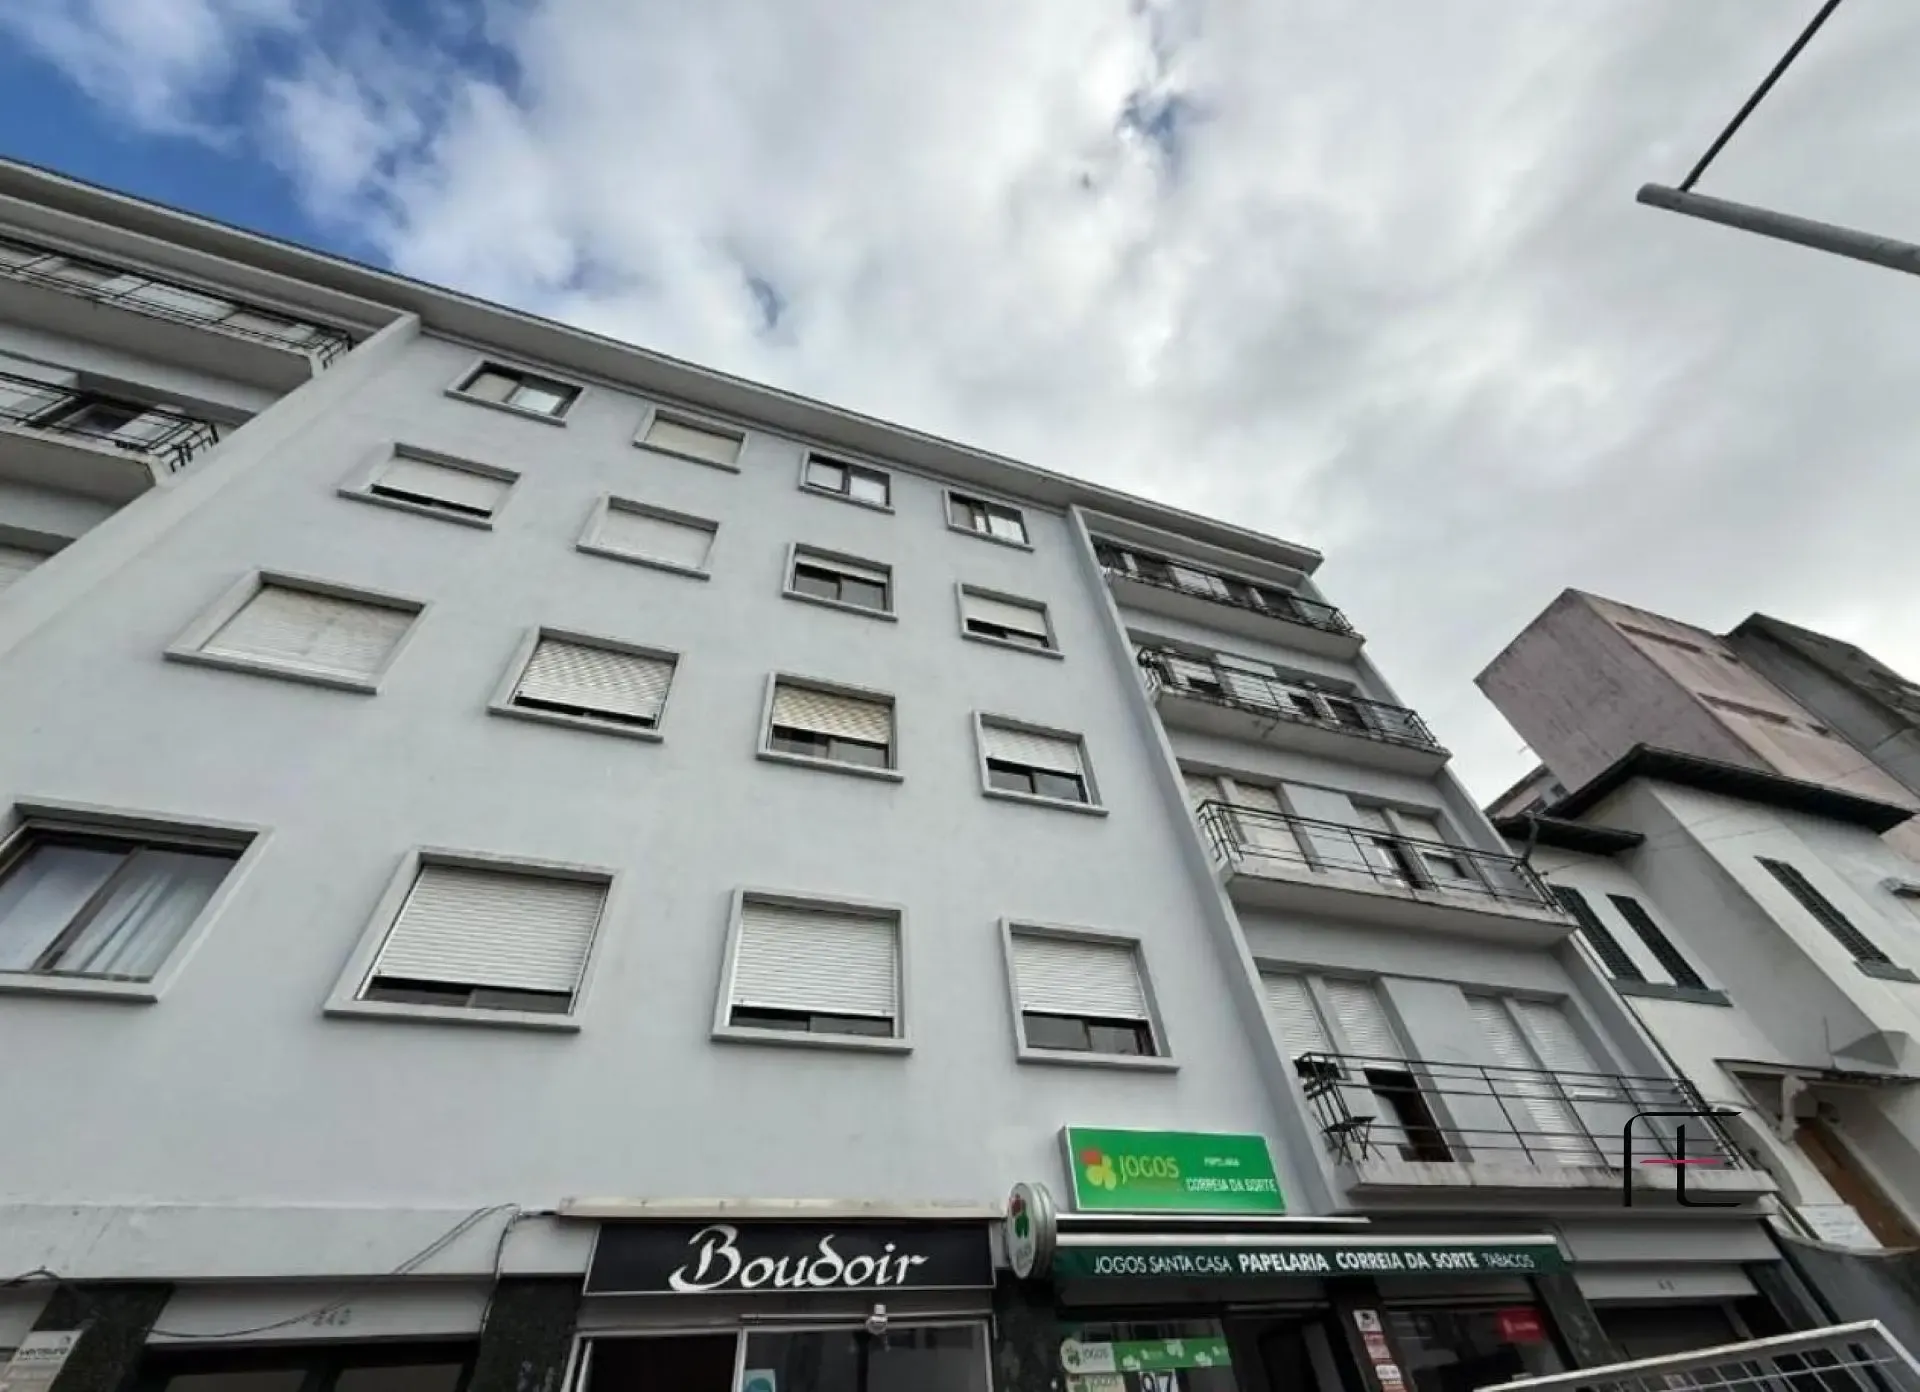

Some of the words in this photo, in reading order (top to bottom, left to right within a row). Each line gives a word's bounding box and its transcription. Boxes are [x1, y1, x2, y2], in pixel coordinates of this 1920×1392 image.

[1119, 1154, 1180, 1184] JOGOS
[1229, 1179, 1245, 1191] DA
[668, 1224, 929, 1292] Boudoir
[1094, 1255, 1147, 1274] JOGOS
[1149, 1254, 1194, 1273] SANTA
[1195, 1255, 1232, 1273] CASA
[1238, 1252, 1329, 1273] PAPELARIA
[1335, 1252, 1404, 1270] CORREIA
[1404, 1252, 1431, 1269] DA
[1430, 1252, 1479, 1269] SORTE
